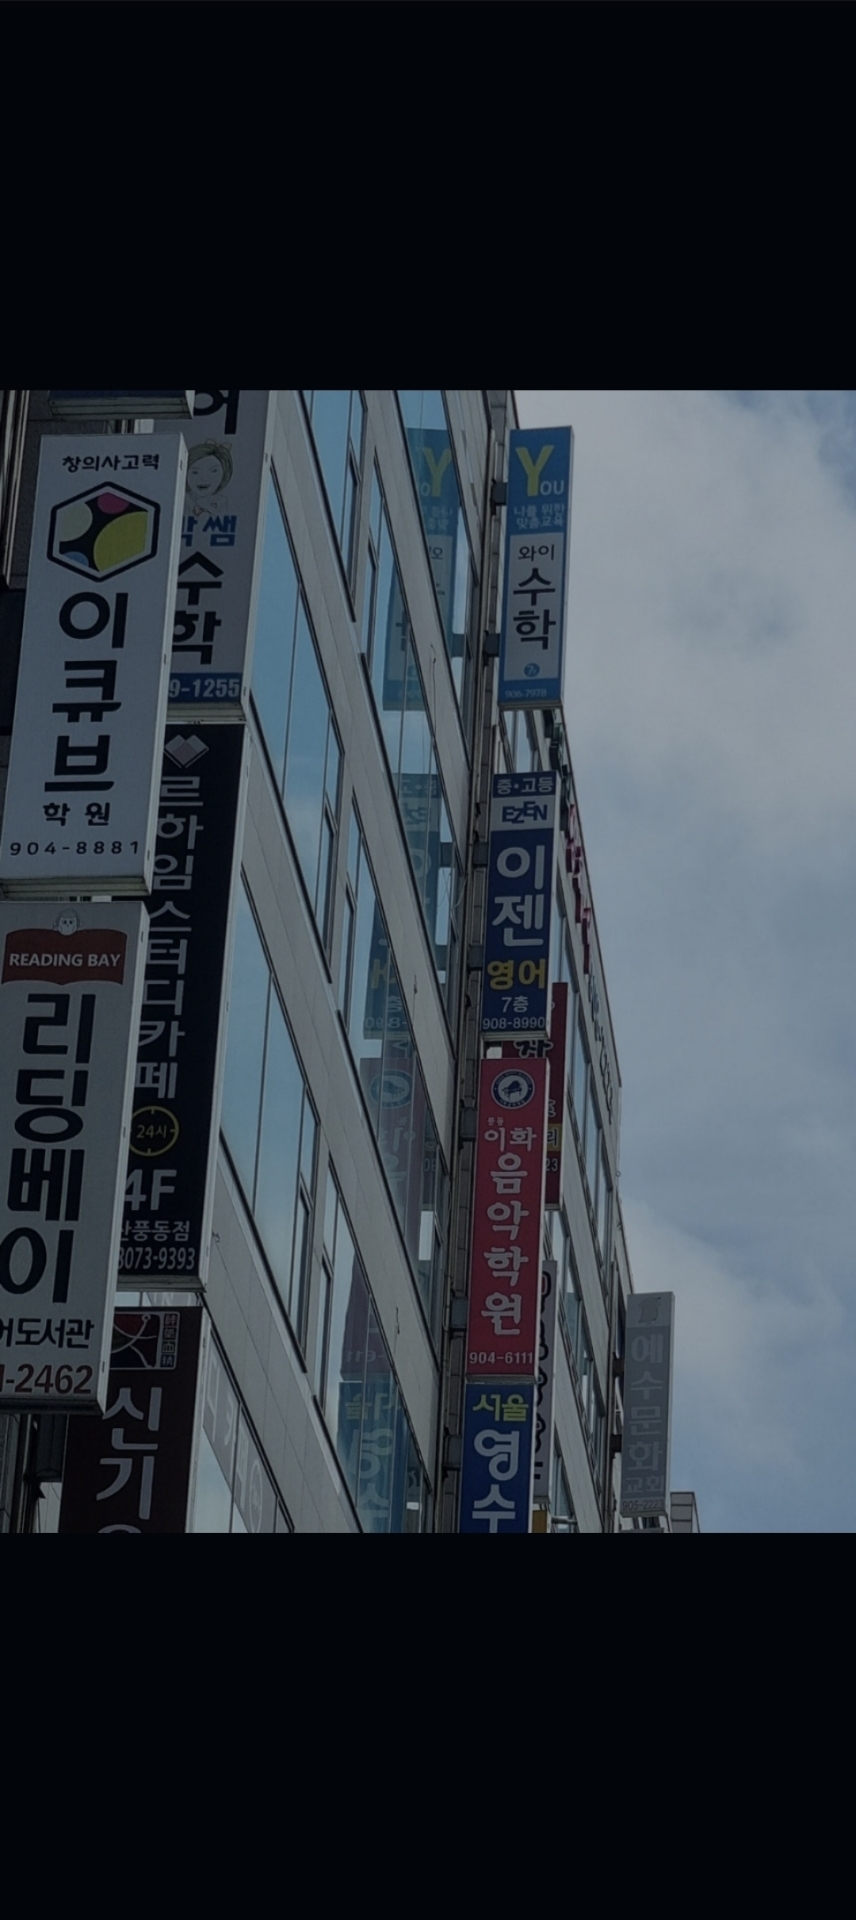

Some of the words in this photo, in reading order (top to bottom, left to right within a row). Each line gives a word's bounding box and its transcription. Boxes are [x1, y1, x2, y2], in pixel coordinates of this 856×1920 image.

[62, 454, 160, 473] 창의사고력
[518, 544, 554, 561] 와이
[513, 567, 556, 650] 수학
[44, 592, 128, 792] 이큐브
[169, 678, 240, 698] 9-1255
[502, 801, 548, 824] EZEN
[10, 840, 139, 856] 904-8881
[492, 845, 545, 947] 이젠
[9, 953, 83, 967] READING
[87, 953, 121, 967] BAY
[487, 958, 546, 990] 영어
[501, 996, 529, 1013] 7층
[482, 1016, 545, 1031] 908-8990
[136, 1124, 167, 1140] 24시
[484, 1127, 537, 1151] 이화
[0, 994, 96, 1303] 리딩베이
[124, 1169, 178, 1211] 4F
[481, 1152, 529, 1336] 음악학원
[469, 1351, 534, 1365] 904-6111
[472, 1393, 529, 1422] 서울
[96, 1387, 163, 1533] 신기
[623, 1475, 664, 1494] 교회
